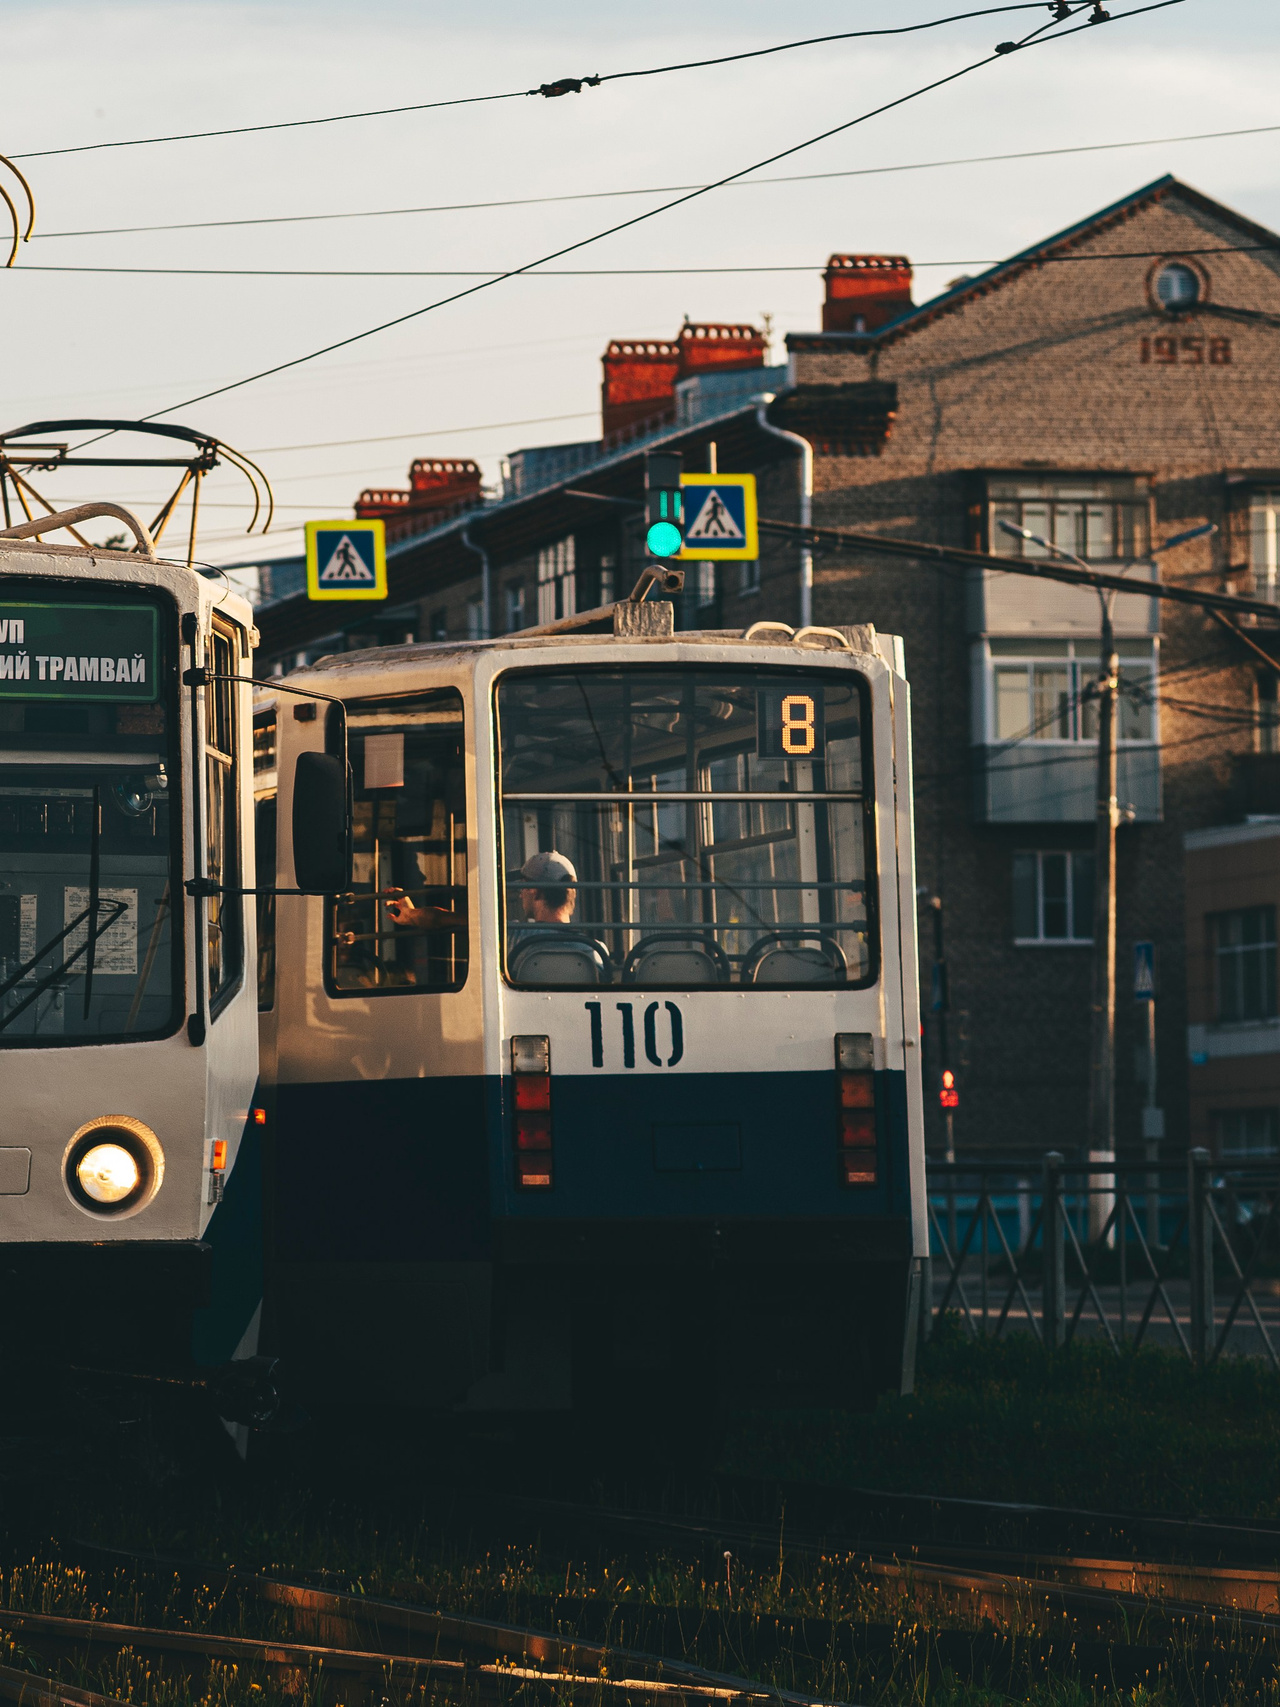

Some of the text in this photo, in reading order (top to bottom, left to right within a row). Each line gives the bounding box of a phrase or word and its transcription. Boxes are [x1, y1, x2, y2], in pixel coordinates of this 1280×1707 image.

[1140, 337, 1233, 365] 1958
[35, 653, 146, 683] ТРАМВАЙ
[781, 695, 815, 754] 8
[585, 1001, 684, 1068] 110
